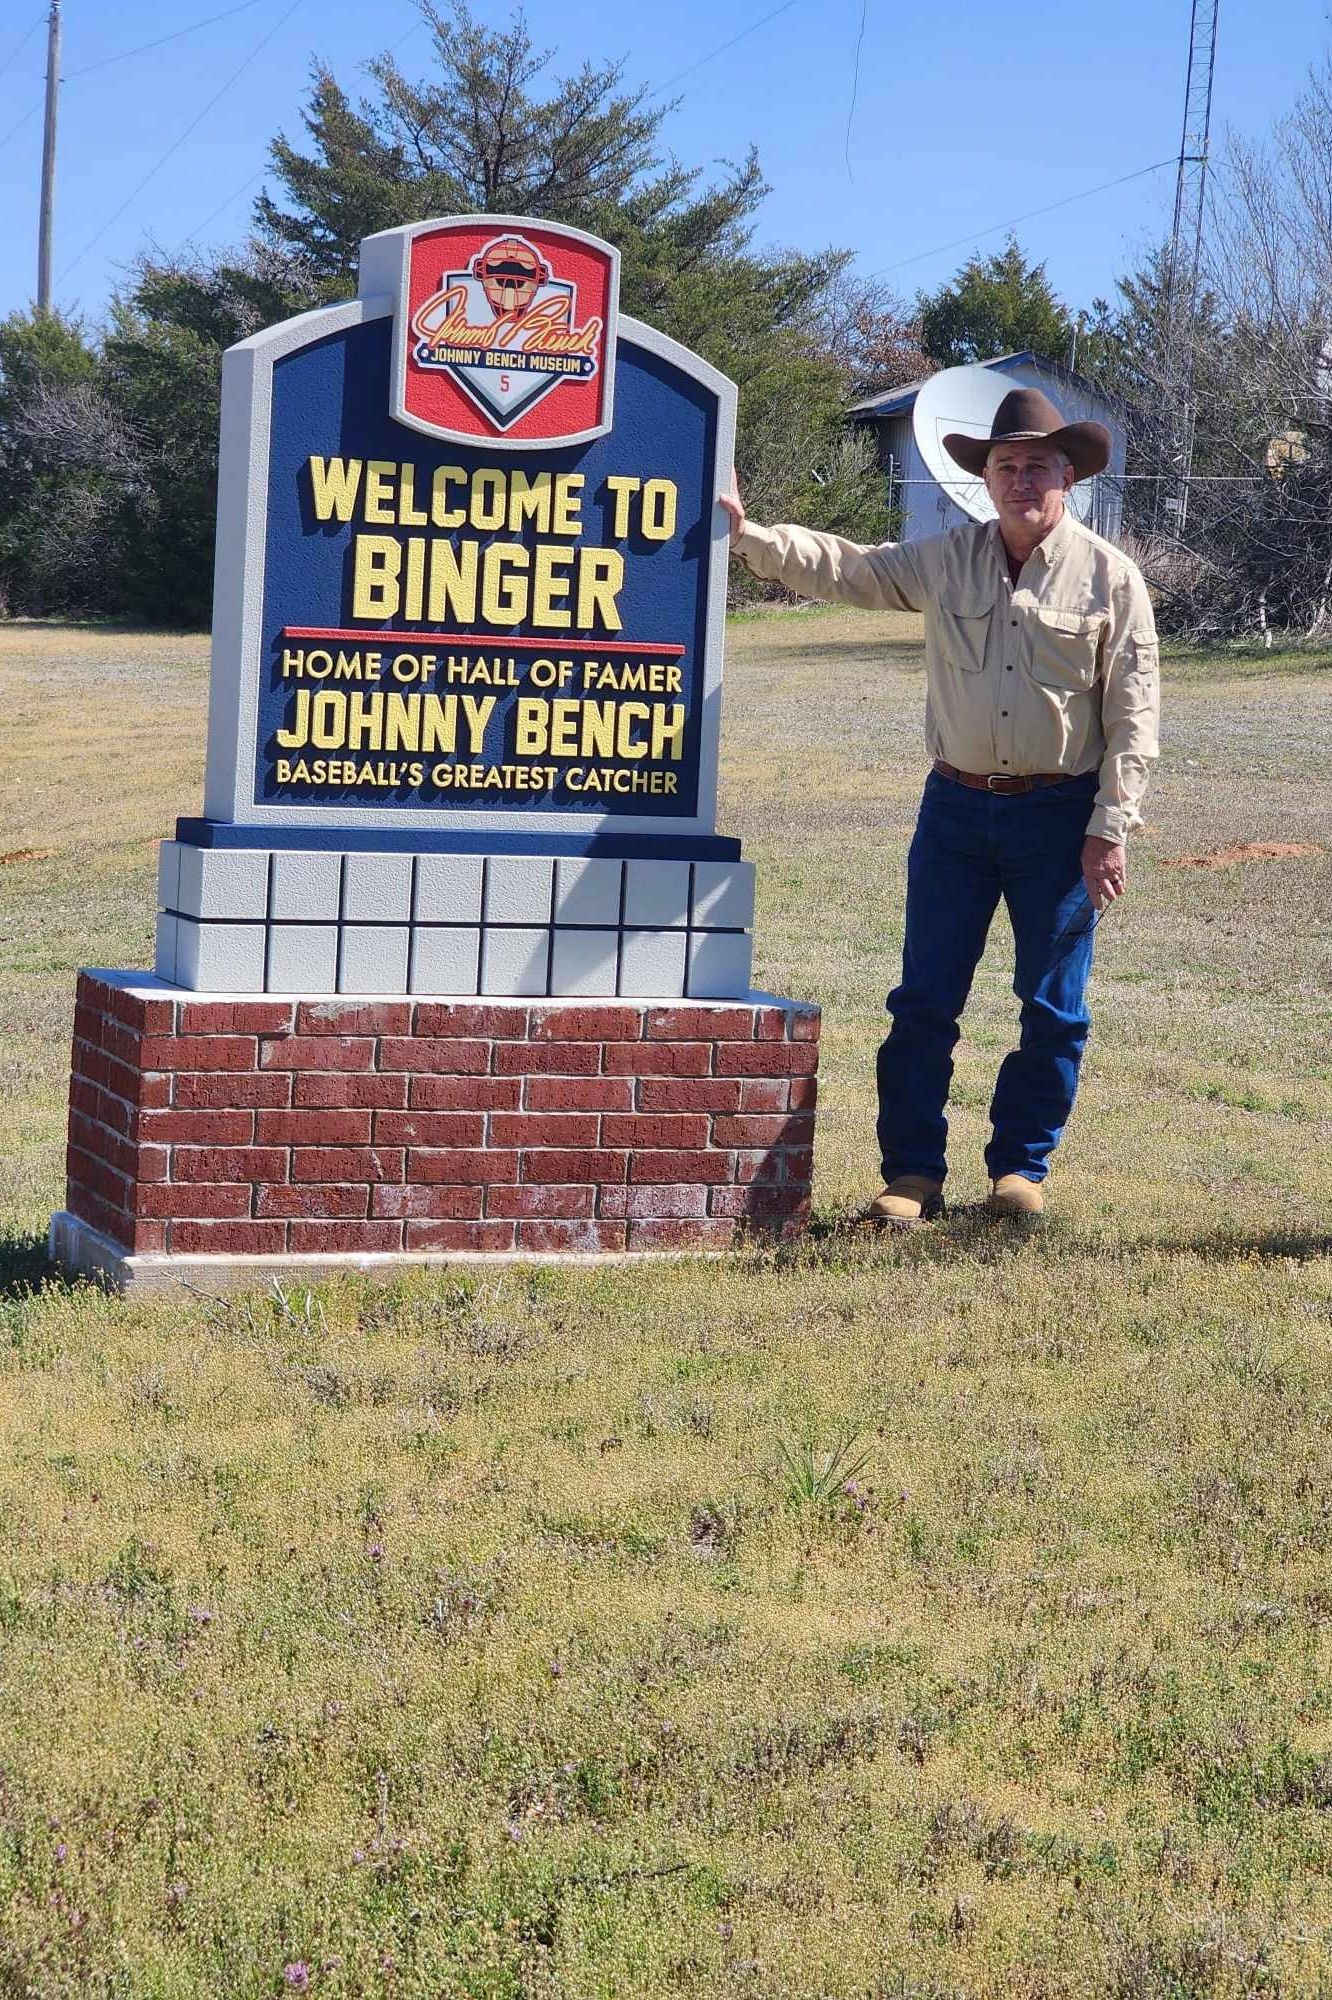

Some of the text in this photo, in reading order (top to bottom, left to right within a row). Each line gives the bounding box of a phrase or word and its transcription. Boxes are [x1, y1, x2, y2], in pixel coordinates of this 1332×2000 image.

[431, 350, 581, 373] JOHNNY BENCH MUSEUM
[500, 375, 510, 392] 5
[308, 456, 678, 541] WELCOME TO
[352, 534, 625, 630] BINGER
[283, 649, 683, 693] HOME OF HALL OF FAMER
[276, 689, 685, 761] JOHNNY BENCH
[276, 759, 678, 794] BASEBALL'S GREATEST CATCHER
